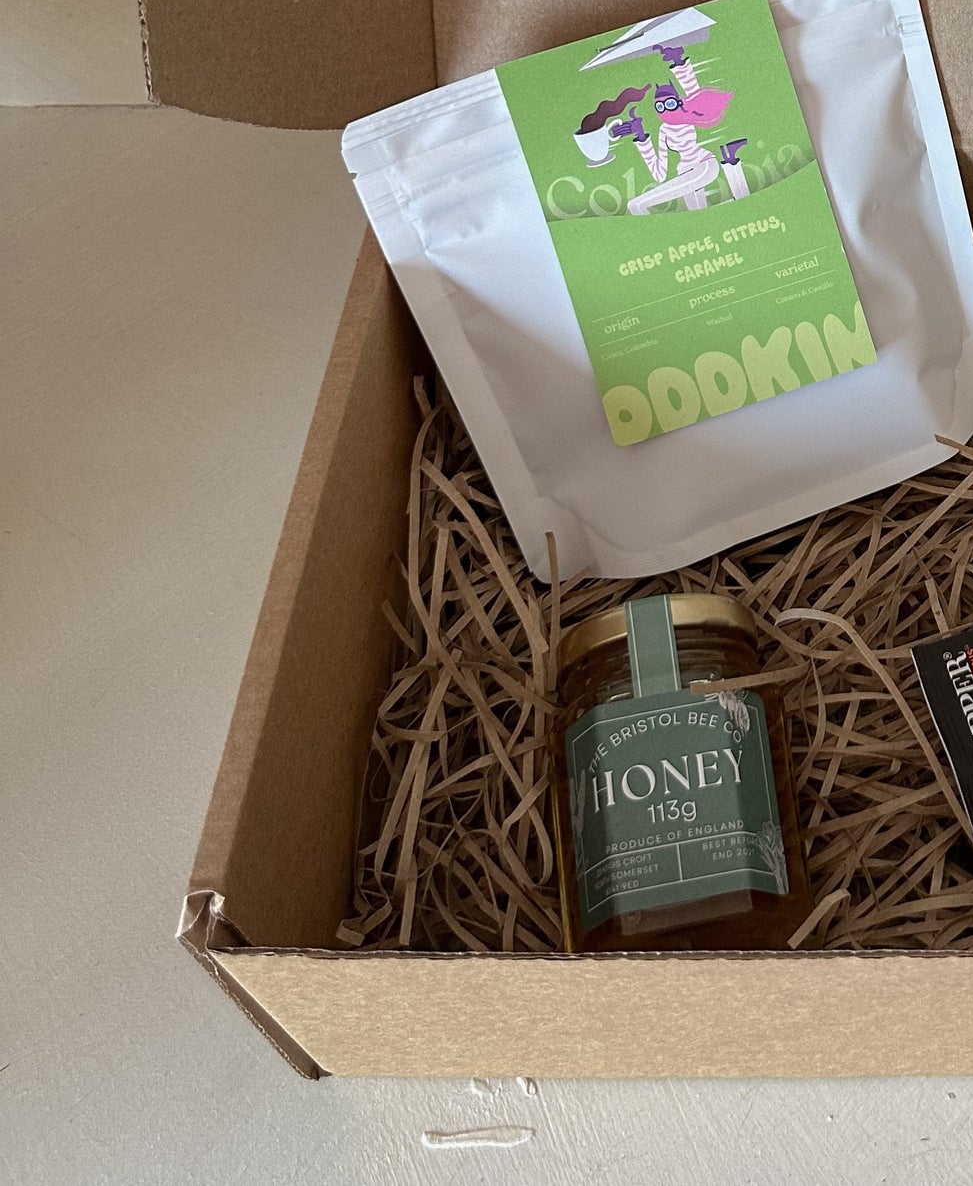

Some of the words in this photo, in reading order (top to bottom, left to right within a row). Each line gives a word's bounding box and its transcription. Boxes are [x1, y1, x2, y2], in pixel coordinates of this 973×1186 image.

[618, 252, 664, 277] CRISP
[668, 235, 720, 263] APPLE,
[722, 215, 786, 244] CITRUS,
[675, 252, 744, 283] CARAMEL
[774, 255, 820, 279] varietal
[688, 285, 736, 308] process
[604, 316, 640, 334] origin
[588, 742, 609, 773] THE
[609, 712, 681, 747] BRISTOL
[688, 711, 719, 728] BEE
[592, 748, 743, 813] HONEY
[647, 799, 697, 823] 113g
[605, 834, 662, 854] PRODUCE
[667, 830, 682, 841] OF
[688, 819, 744, 837] ENGLAND
[702, 838, 726, 850] BEST
[712, 849, 733, 860] END
[611, 863, 660, 881] SOMERSET
